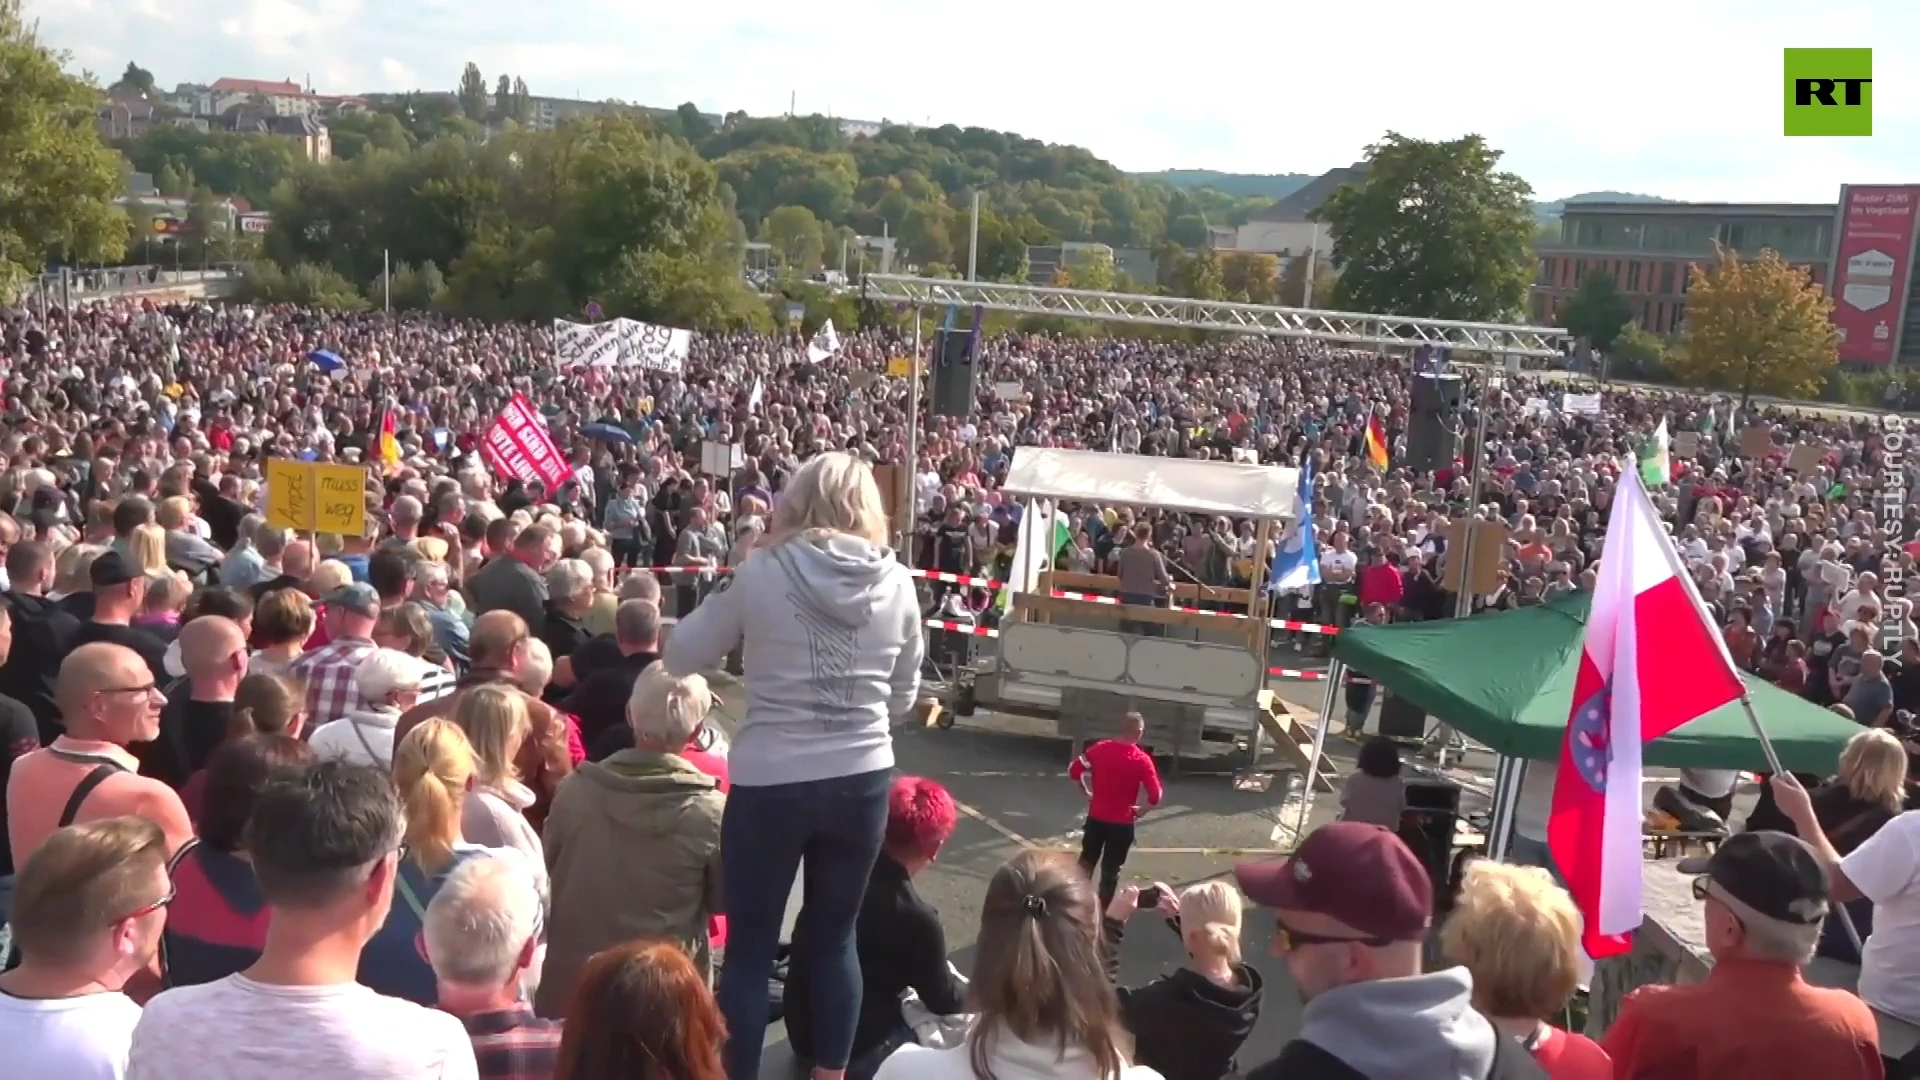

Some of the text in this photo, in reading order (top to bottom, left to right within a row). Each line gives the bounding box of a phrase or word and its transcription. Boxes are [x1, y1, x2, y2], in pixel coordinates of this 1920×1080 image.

[641, 324, 672, 349] 89
[517, 425, 548, 460] SIND
[322, 477, 360, 492] muss
[276, 471, 306, 526] Ampel
[325, 501, 356, 528] weg
